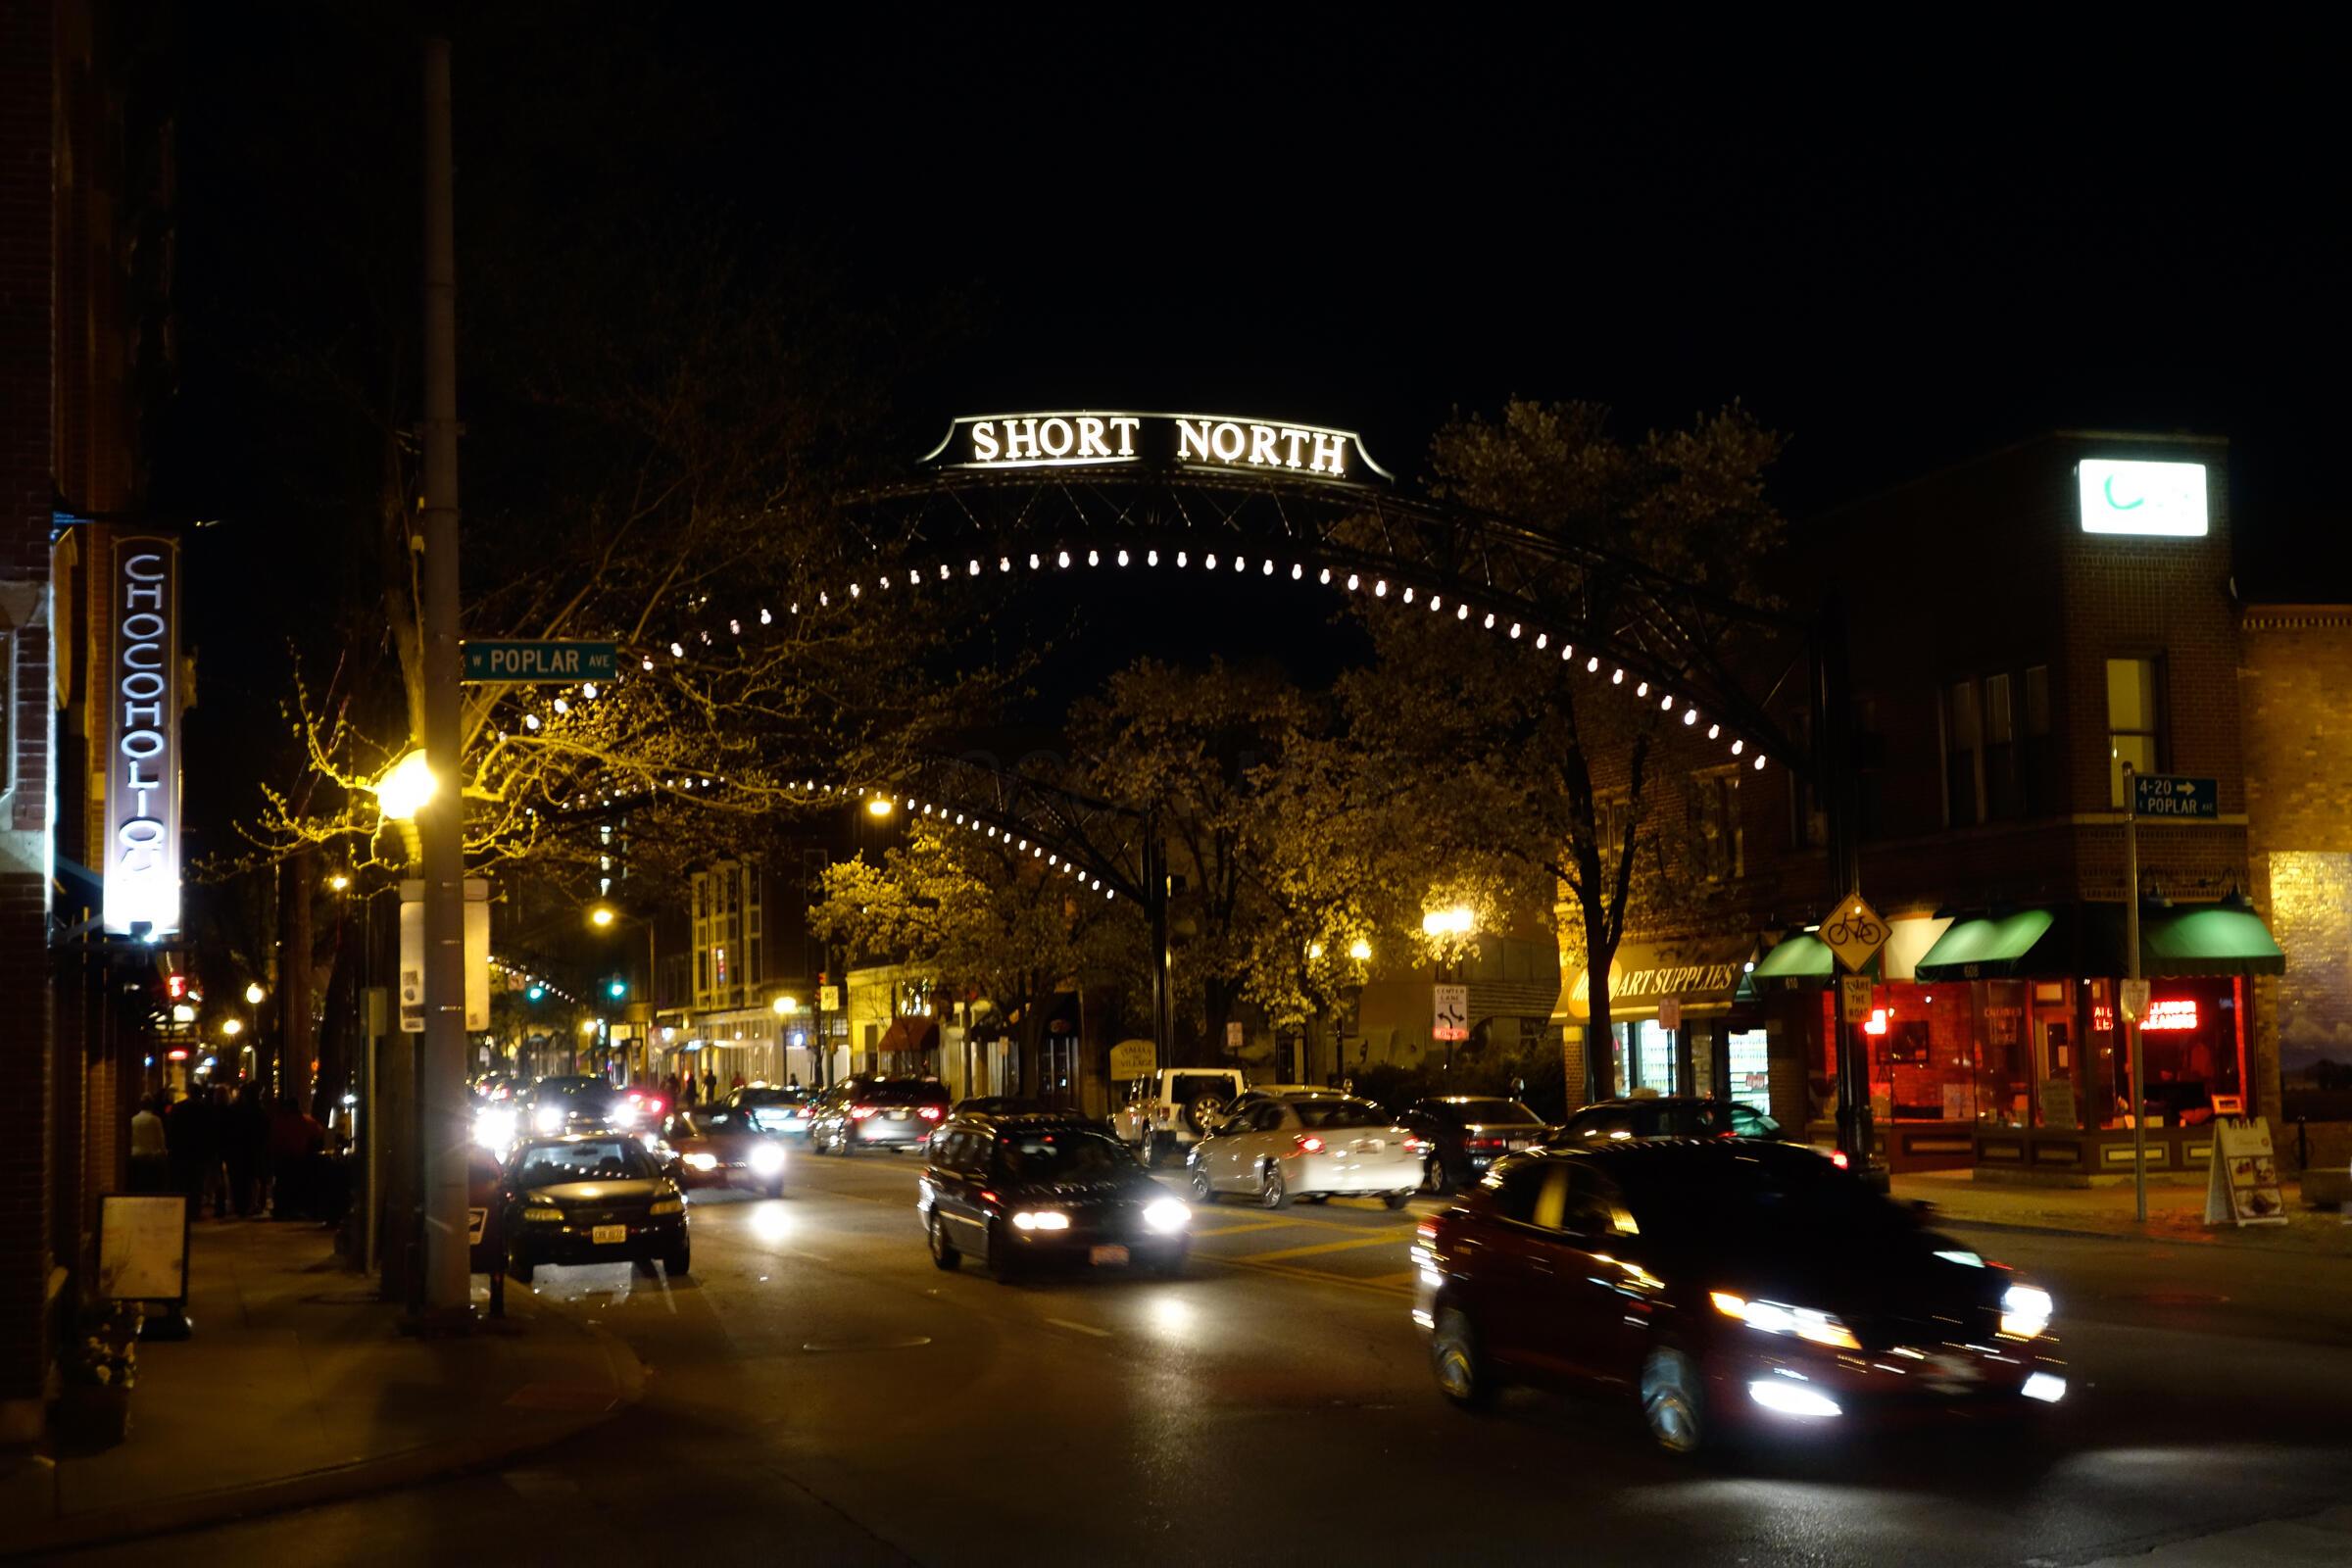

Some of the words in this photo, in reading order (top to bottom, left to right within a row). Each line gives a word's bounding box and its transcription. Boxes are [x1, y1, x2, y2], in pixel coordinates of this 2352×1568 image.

[971, 417, 1140, 461] SHORT
[1175, 419, 1346, 475] NORTH
[472, 654, 482, 666] W
[490, 648, 580, 673] POPLAR
[589, 654, 611, 667] AVE
[2139, 778, 2173, 796] 4-20
[2147, 797, 2197, 814] POPLAR
[1615, 969, 1656, 997] ART
[1650, 962, 1737, 995] SUPPLIES
